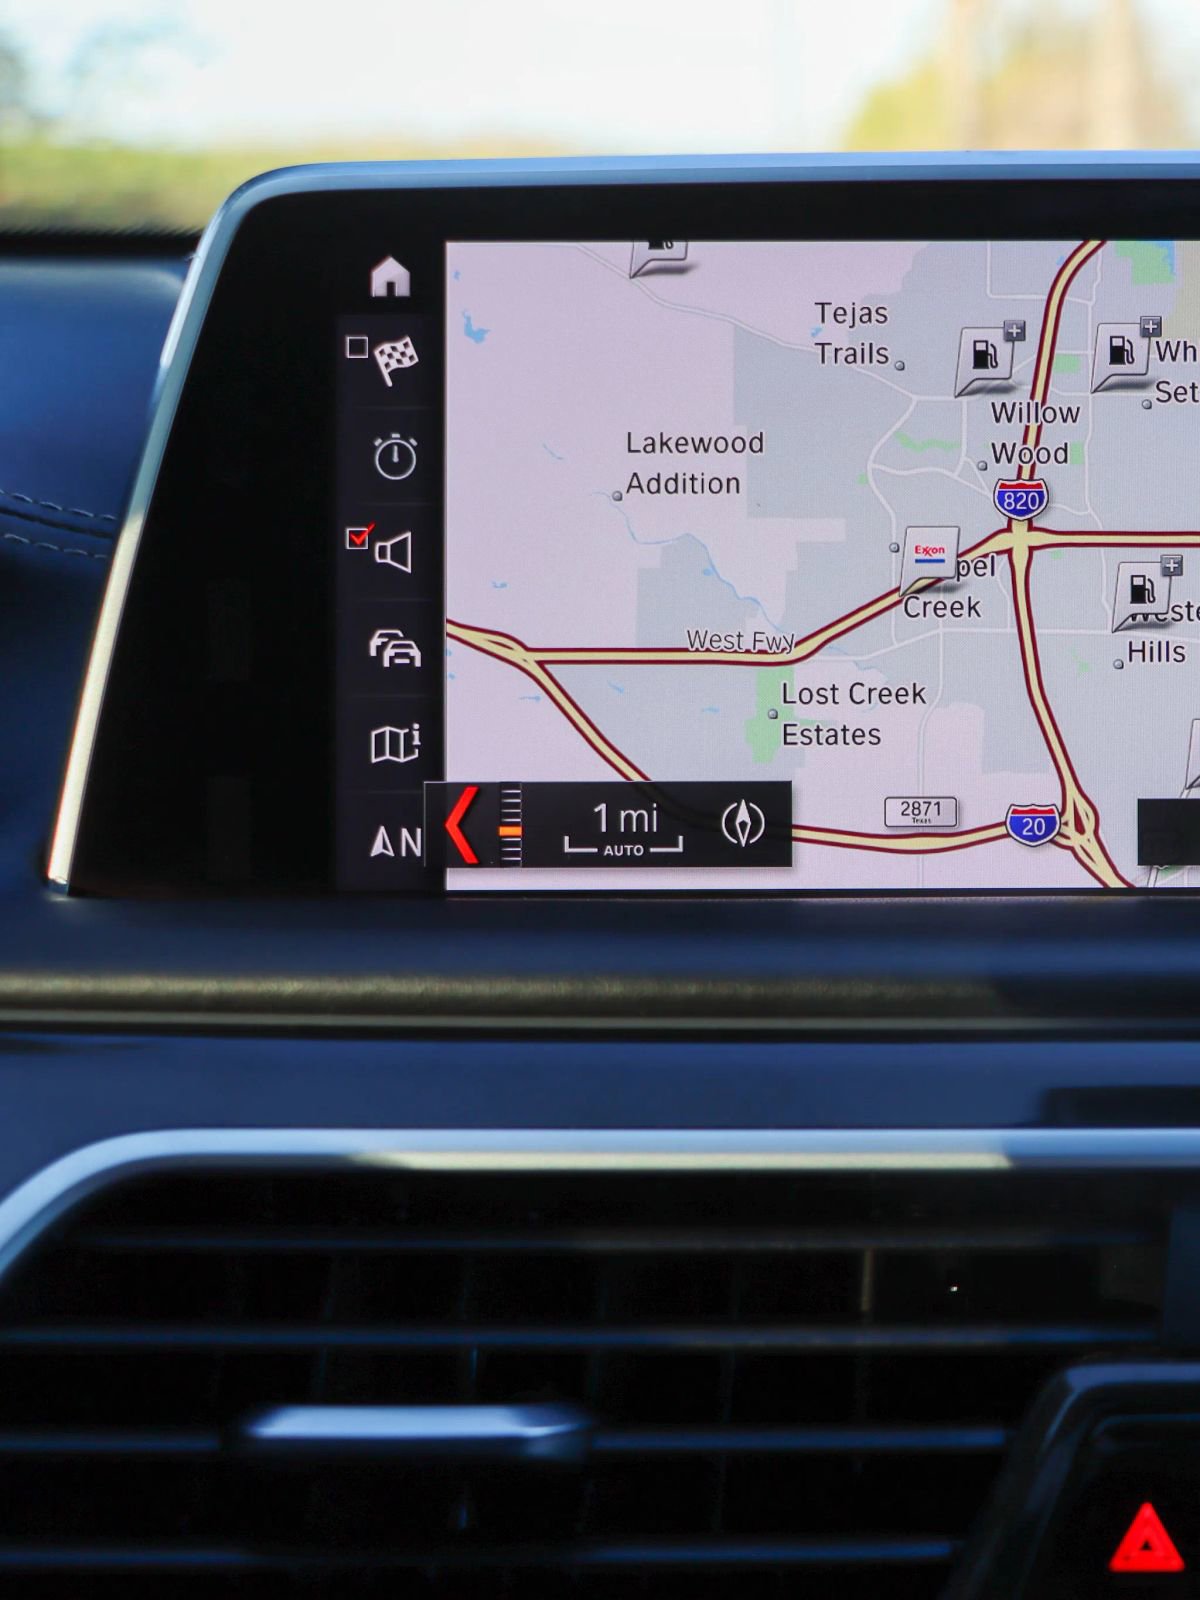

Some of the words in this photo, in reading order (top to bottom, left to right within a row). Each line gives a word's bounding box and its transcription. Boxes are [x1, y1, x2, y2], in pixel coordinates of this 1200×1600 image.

[815, 302, 888, 328] Tejas
[815, 342, 889, 365] Trails
[991, 401, 1081, 424] Willow
[627, 432, 765, 455] Lakewood
[991, 442, 1069, 465] Wood
[626, 472, 741, 495] Addition
[1003, 492, 1040, 511] 820
[914, 545, 945, 557] Exxon
[956, 554, 995, 582] pel
[904, 596, 981, 618] Creek
[687, 629, 743, 651] West
[752, 631, 796, 653] Fwy
[1128, 641, 1186, 663] Hills
[782, 682, 840, 704] Lost
[848, 682, 927, 705] Creek
[782, 722, 882, 746] Estates
[593, 803, 607, 832] 1
[619, 803, 658, 832] mi
[900, 800, 942, 818] 2871
[1022, 817, 1047, 836] 20
[603, 845, 645, 857] AUTO
